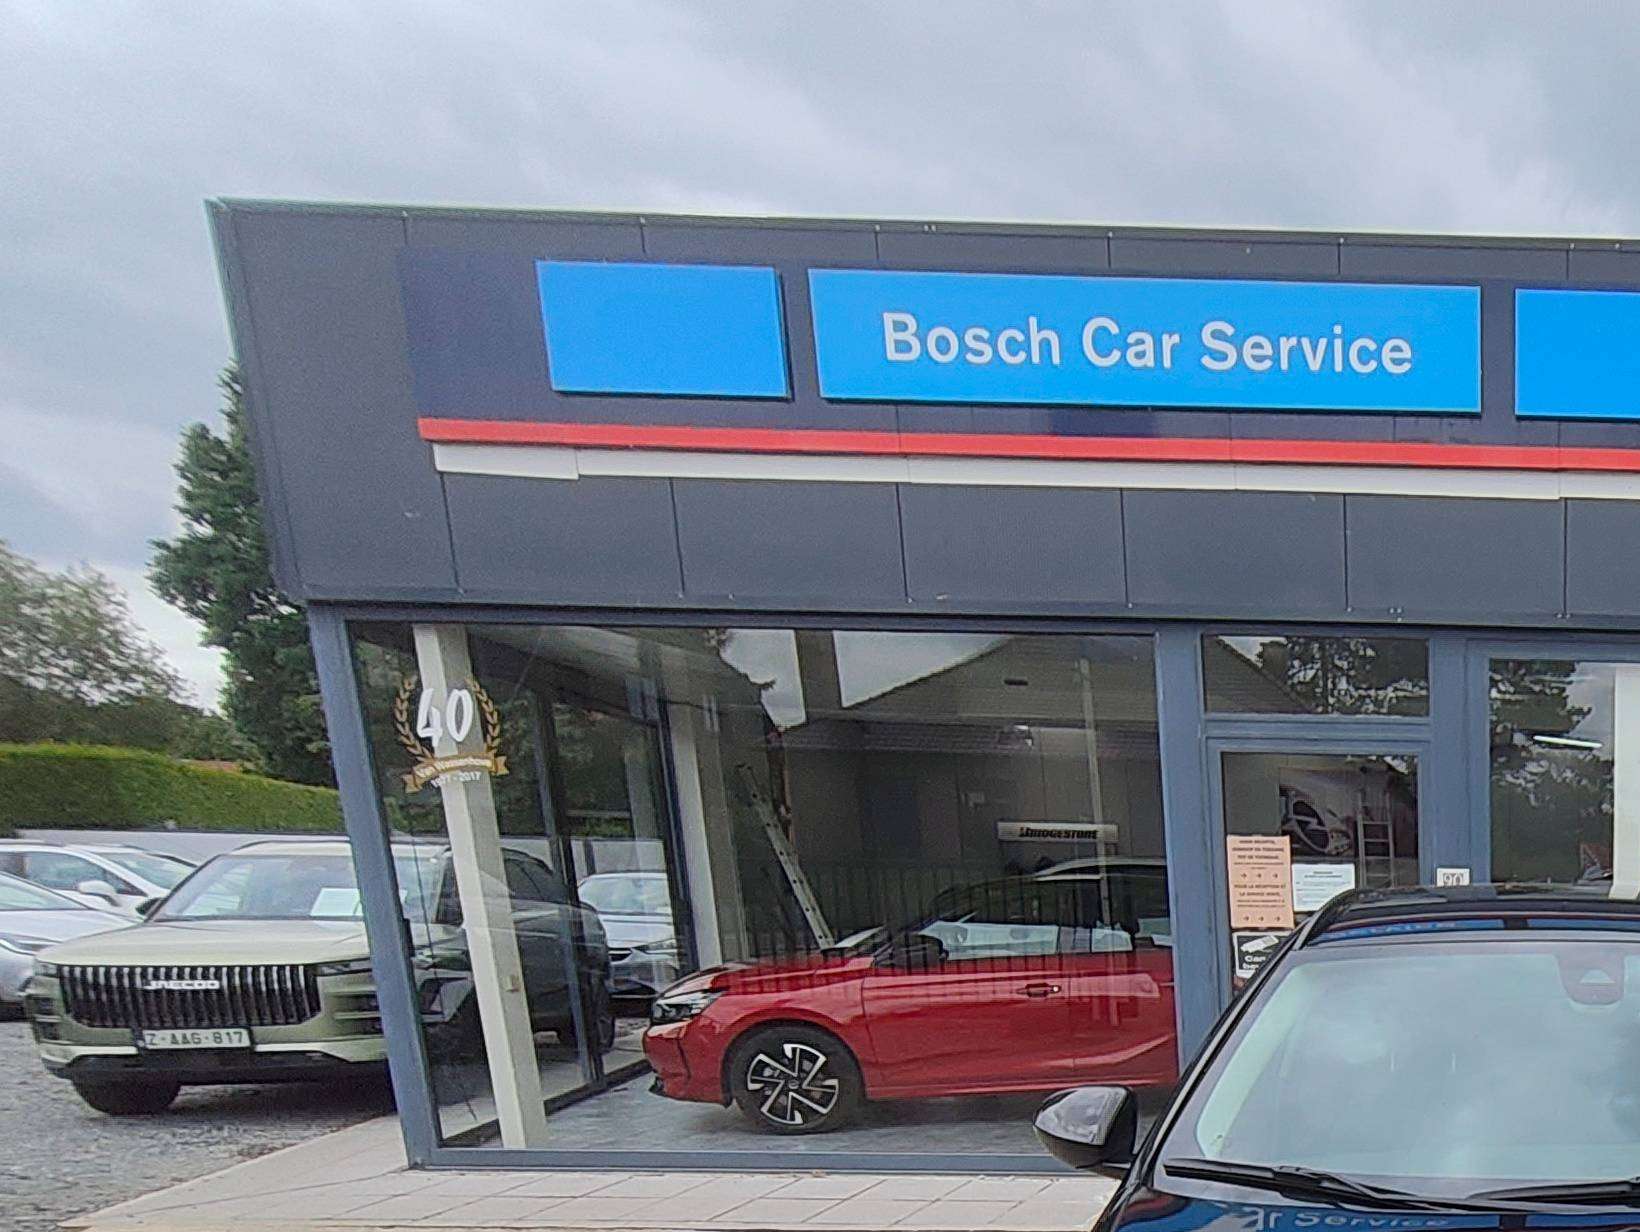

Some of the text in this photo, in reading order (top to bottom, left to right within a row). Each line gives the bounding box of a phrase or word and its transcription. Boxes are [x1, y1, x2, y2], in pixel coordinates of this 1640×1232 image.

[882, 311, 1413, 375] Bosch Car Service
[417, 688, 473, 748] 40
